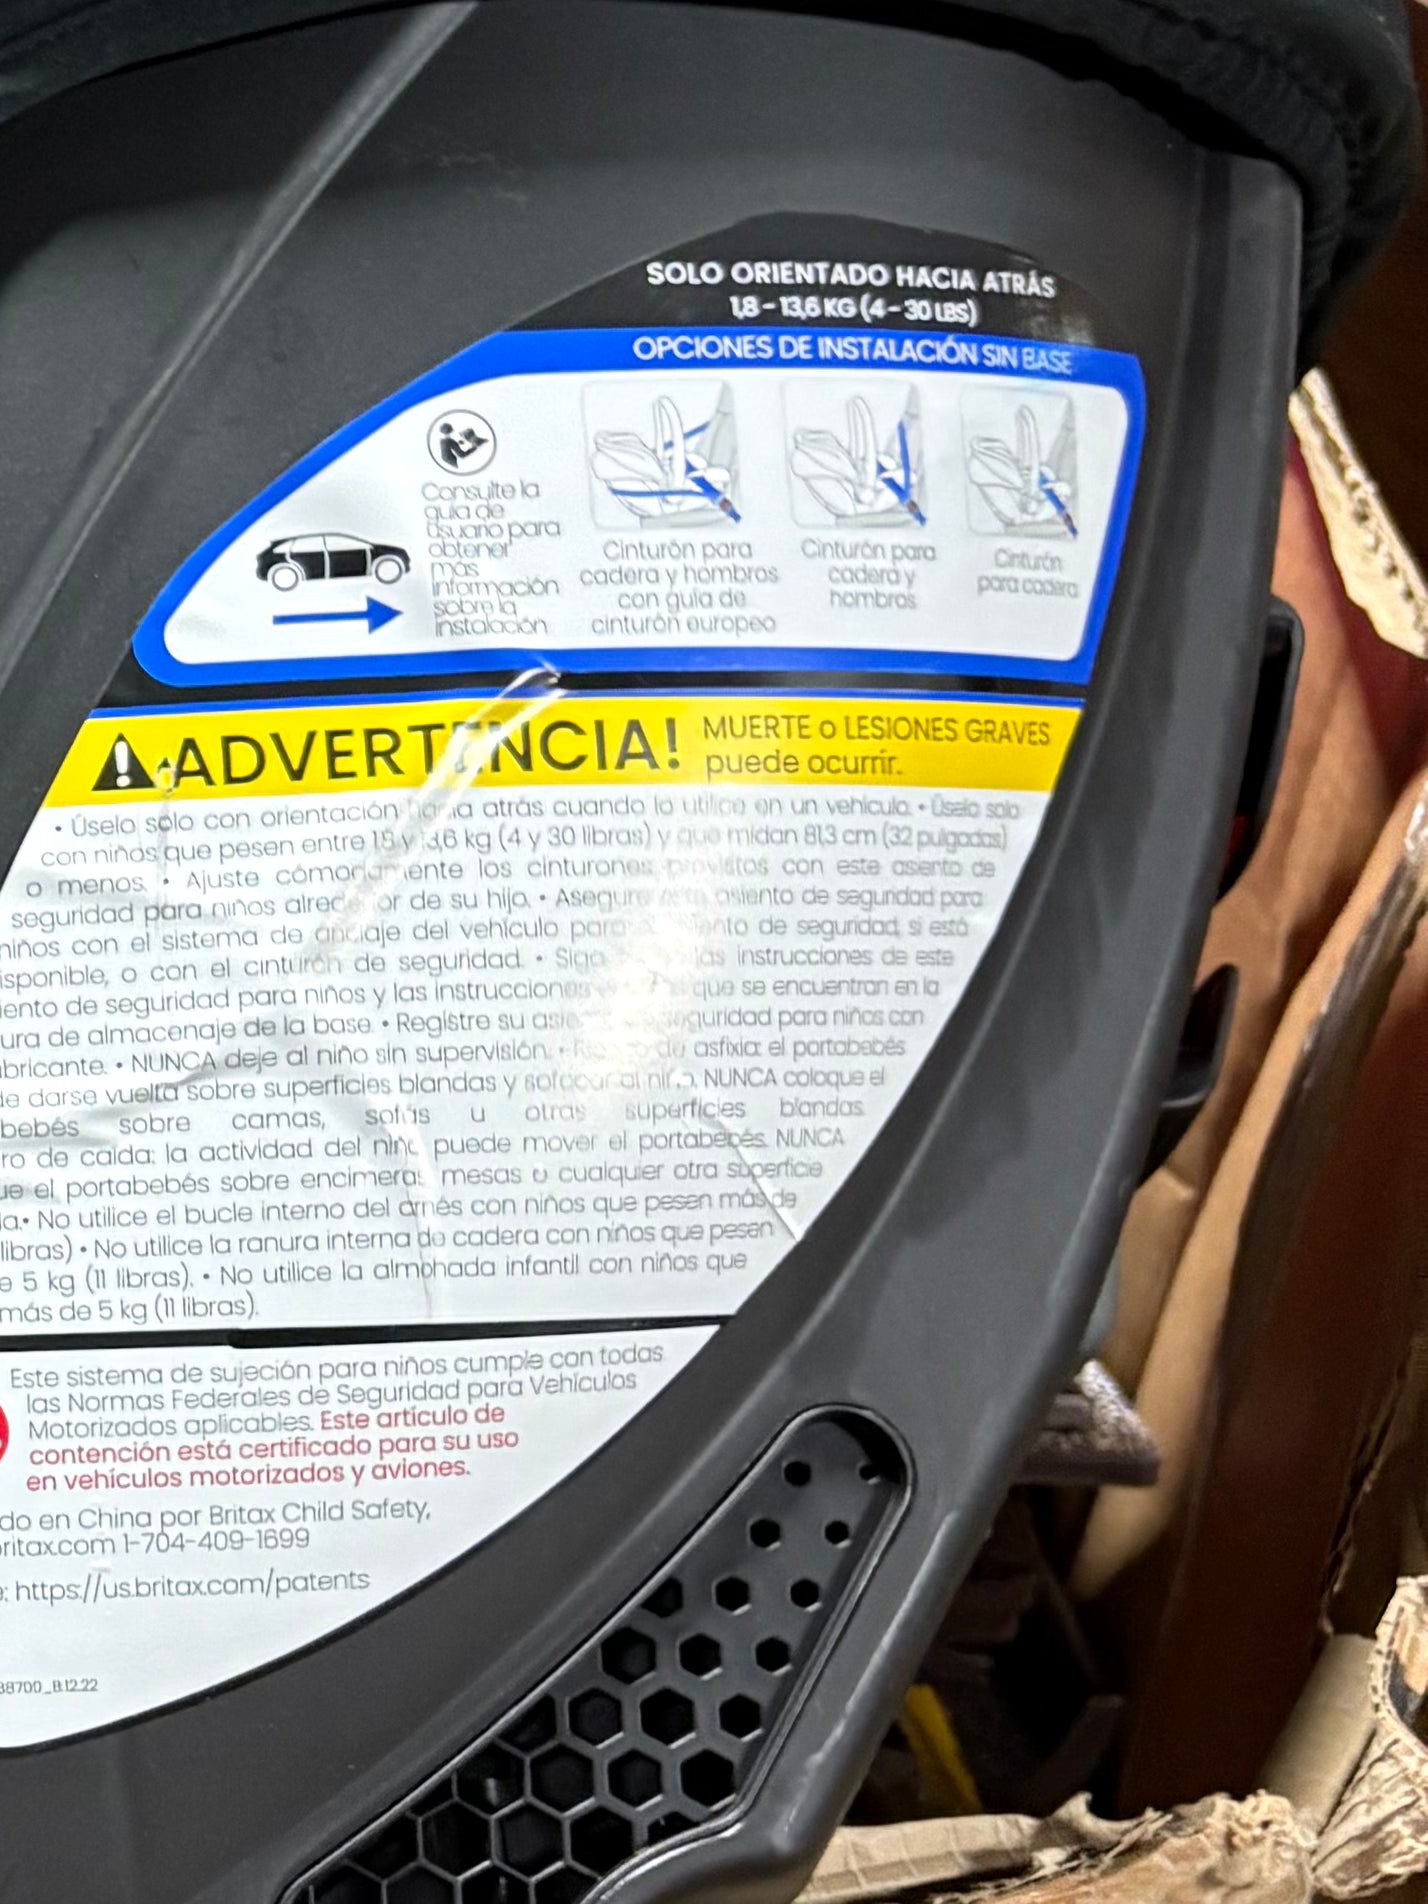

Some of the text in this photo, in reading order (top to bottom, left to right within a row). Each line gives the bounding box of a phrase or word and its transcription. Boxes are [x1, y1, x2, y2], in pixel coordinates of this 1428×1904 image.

[646, 260, 1058, 299] SOLO ORIENTADO HACIA ATRÁS
[631, 334, 1076, 374] OPCIONES DE INSTALACIÓN SIN BASE
[702, 714, 813, 741] MUERTE
[843, 714, 959, 743] LESIONES
[964, 718, 1051, 747] GRAVES
[705, 748, 904, 782] puede ocurrir.
[58, 1299, 93, 1322] de
[119, 1297, 148, 1326] kg
[181, 1288, 260, 1321] libras).
[9, 1343, 664, 1390] Este sistema de sujeción para niños cumple con todas
[26, 1392, 62, 1415] las
[67, 1391, 165, 1413] Normas
[171, 1386, 292, 1411] Federales
[297, 1383, 331, 1407] de
[336, 1377, 461, 1409] Seguridad
[467, 1379, 524, 1406] para
[28, 1414, 178, 1441] Motorizados
[183, 1411, 315, 1442] aplicables.
[320, 1409, 370, 1432] Este
[473, 1401, 506, 1425] de
[28, 1431, 520, 1467] contención está certificado para su uso
[25, 1474, 58, 1493] en
[63, 1466, 184, 1491] vehículos
[189, 1461, 346, 1488] motorizados
[370, 1456, 472, 1481] aviones.
[38, 1512, 71, 1532] en
[77, 1506, 153, 1531] China
[157, 1508, 203, 1535] por
[209, 1504, 276, 1526] Britax
[281, 1499, 345, 1524] Child
[122, 1525, 311, 1555] 1-704-409-1699
